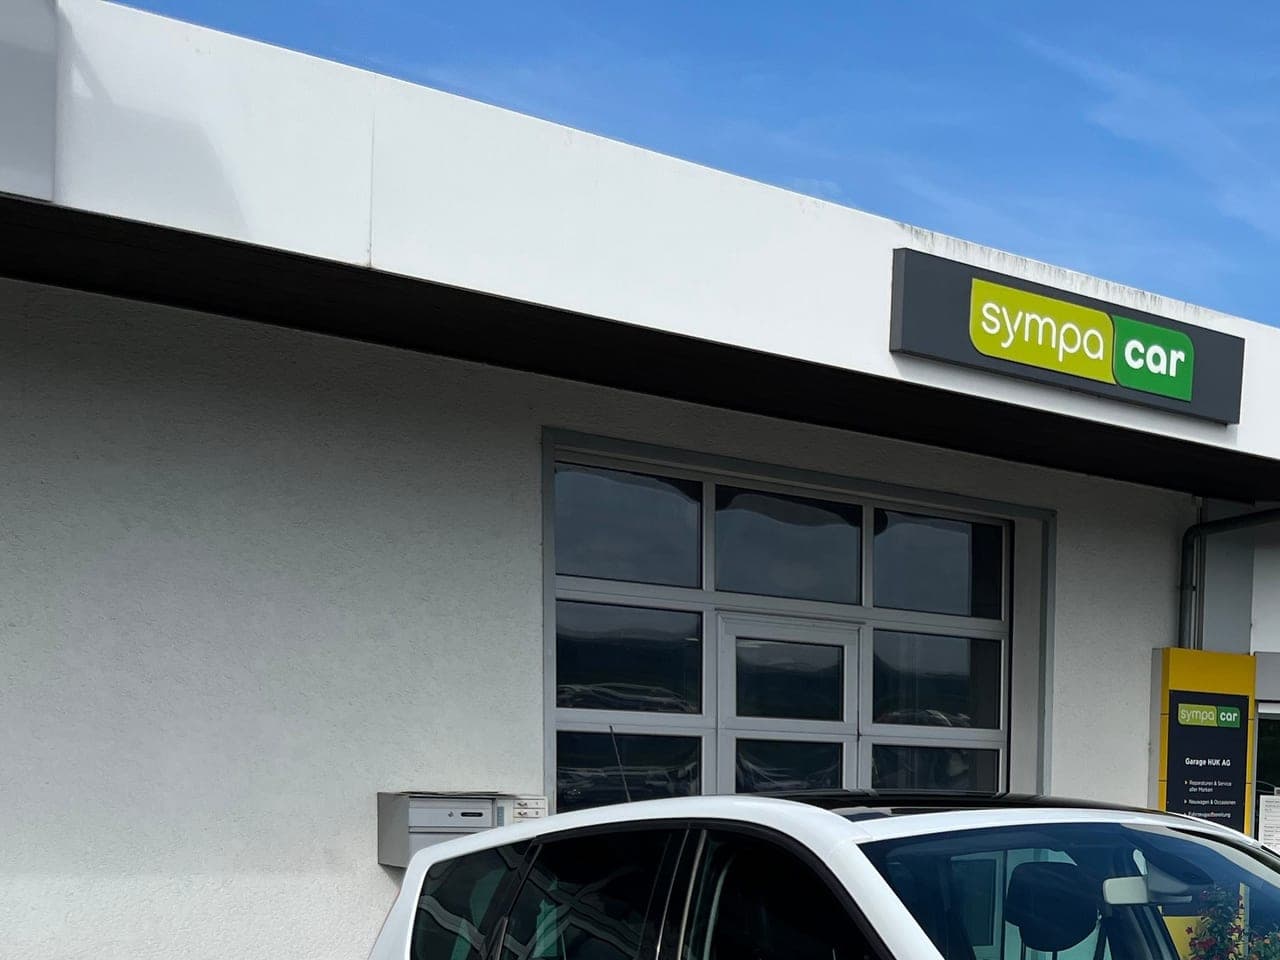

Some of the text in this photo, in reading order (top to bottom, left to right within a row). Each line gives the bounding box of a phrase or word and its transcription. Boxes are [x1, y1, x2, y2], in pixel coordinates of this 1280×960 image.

[980, 301, 1186, 378] sympa car
[1180, 708, 1238, 724] sympa car
[1184, 757, 1231, 767] Garage HUK AG
